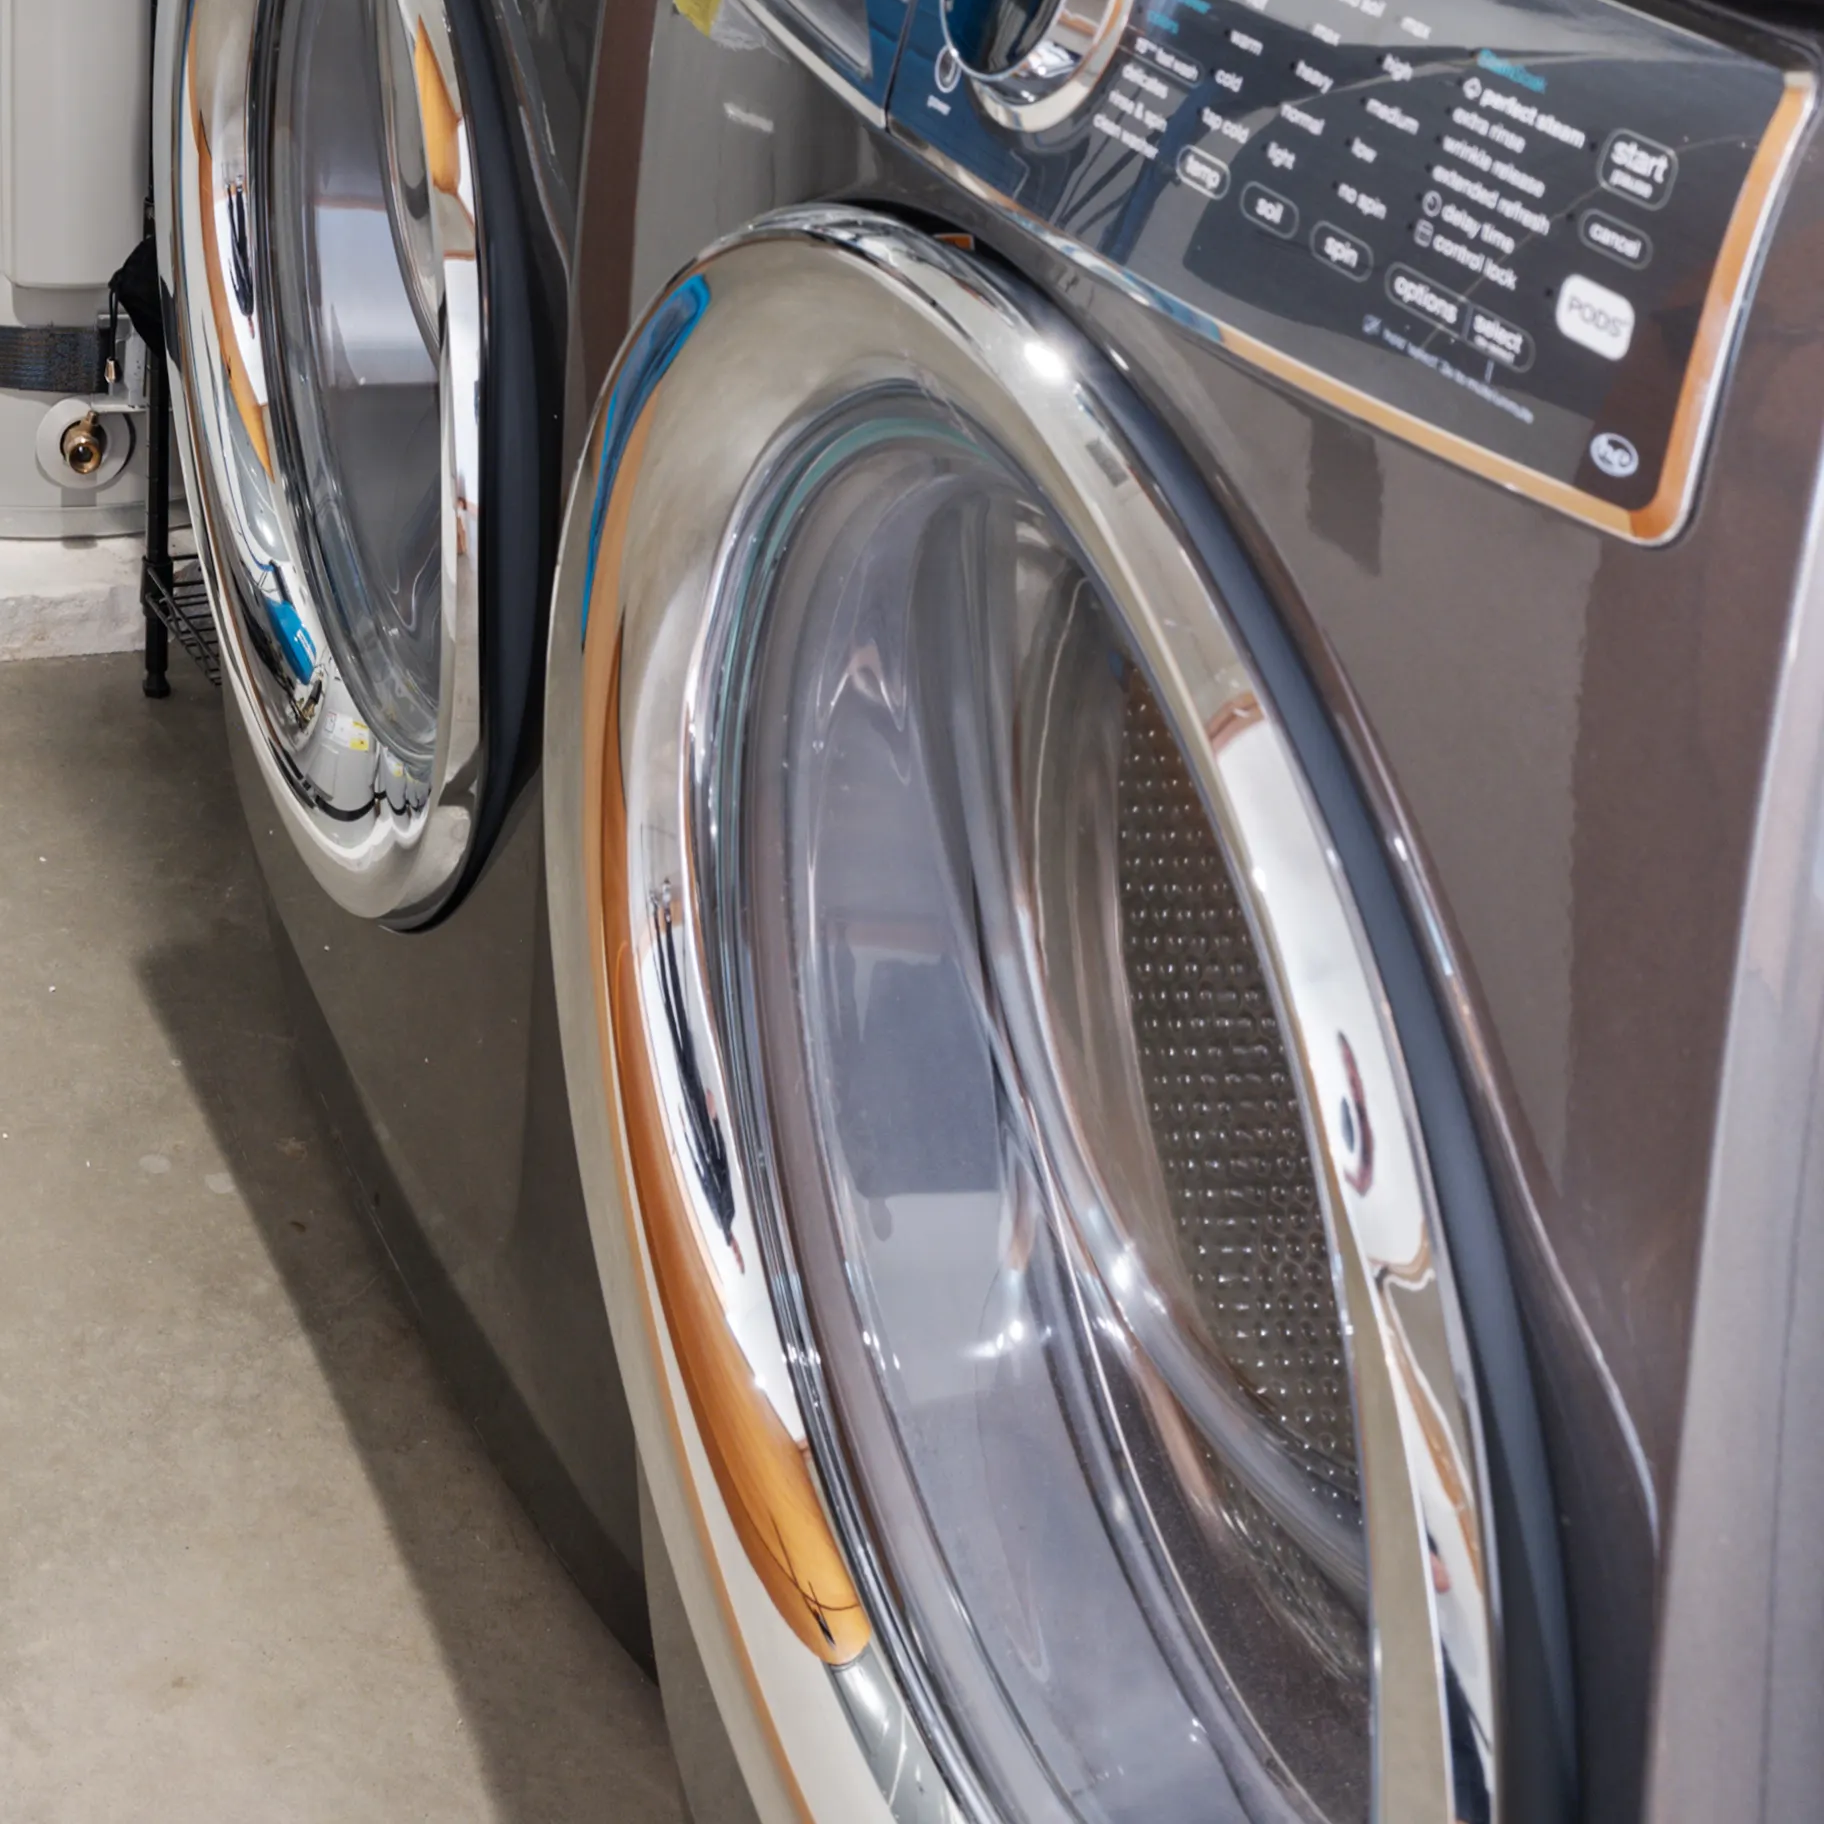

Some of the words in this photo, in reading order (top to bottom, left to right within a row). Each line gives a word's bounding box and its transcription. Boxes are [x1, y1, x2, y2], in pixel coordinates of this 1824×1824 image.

[1230, 29, 1264, 56] warm
[1312, 22, 1341, 47] max
[1401, 16, 1432, 40] max
[1215, 69, 1243, 93] cold
[1296, 60, 1334, 95] heavy
[1383, 53, 1413, 82] high
[1202, 106, 1223, 132] tap
[1222, 118, 1250, 144] cold
[1281, 103, 1325, 136] normal
[1366, 98, 1420, 135] medium
[1452, 107, 1490, 136] extra
[1488, 123, 1526, 154] rinse
[1479, 88, 1538, 126] perfect
[1535, 114, 1586, 149] steam
[1267, 141, 1295, 170] light
[1352, 137, 1377, 164] low
[1442, 135, 1492, 172] wrinkle
[1491, 160, 1546, 199] release
[1611, 140, 1668, 184] start
[1185, 155, 1220, 190] temp
[1609, 169, 1653, 199] pause
[1255, 197, 1284, 224] soil
[1337, 183, 1358, 204] no
[1356, 193, 1387, 220] spin
[1432, 165, 1499, 210] extended
[1497, 197, 1550, 236] refresh
[1441, 204, 1481, 240] delay
[1480, 222, 1515, 254] time
[1589, 222, 1642, 259] cancel
[1325, 236, 1359, 269] spin
[1433, 234, 1485, 273] control
[1483, 257, 1518, 290] lock
[1394, 275, 1458, 325] options
[1474, 315, 1523, 354] select
[1567, 295, 1623, 339] PODS
